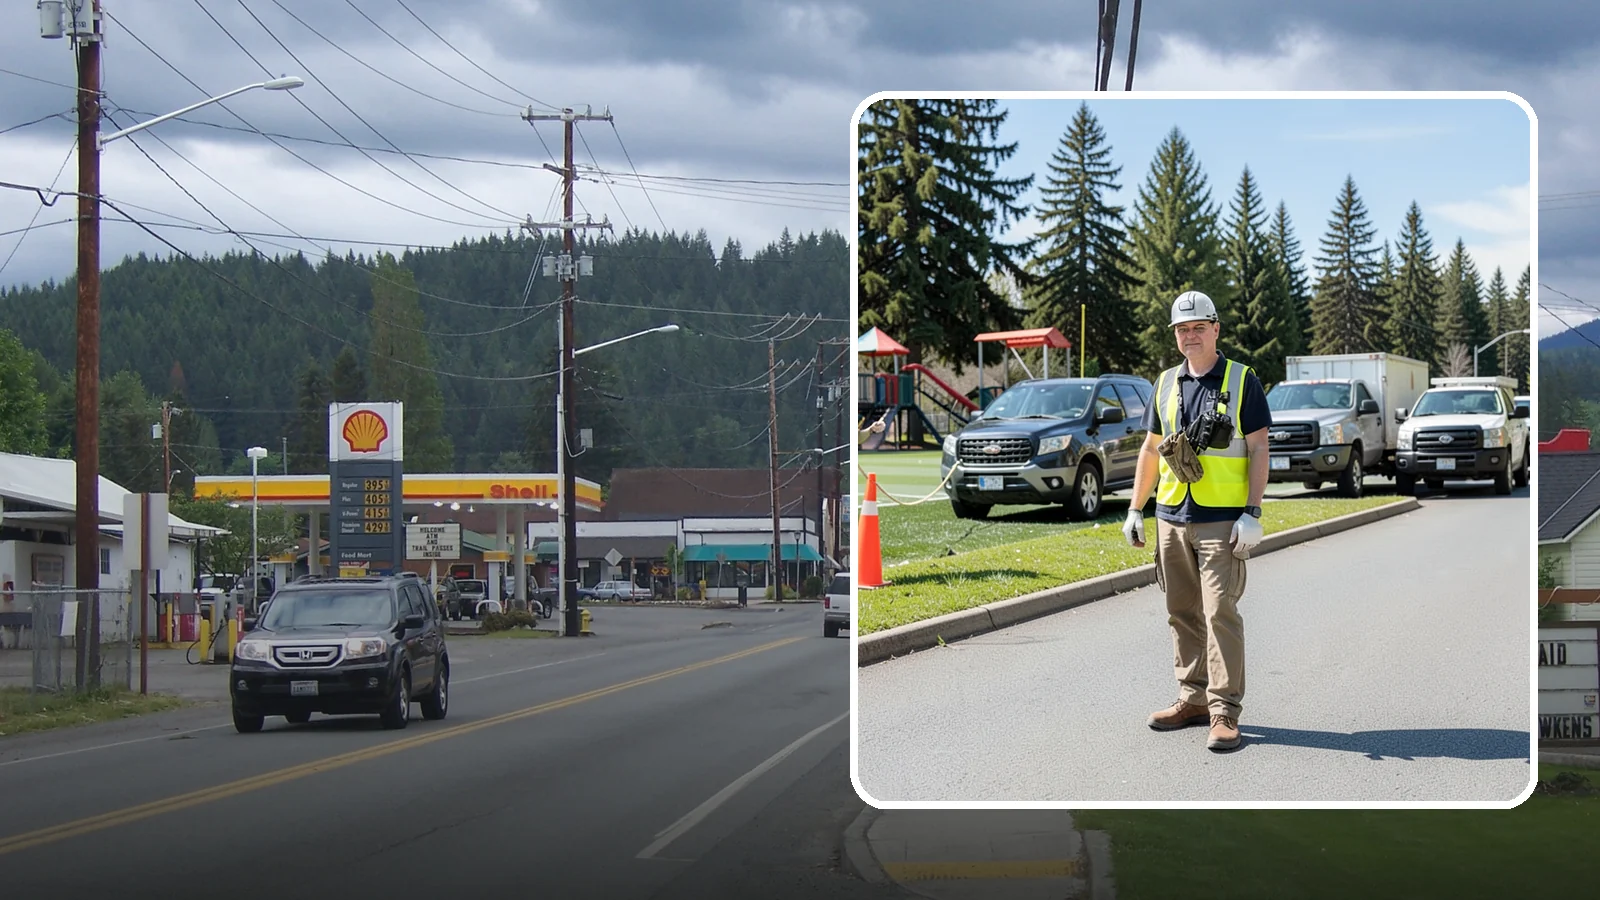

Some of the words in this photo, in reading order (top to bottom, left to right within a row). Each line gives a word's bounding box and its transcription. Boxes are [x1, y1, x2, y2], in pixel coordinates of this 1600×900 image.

[365, 480, 383, 490] 395
[490, 484, 547, 499] Shell
[365, 494, 383, 504] 405
[365, 508, 383, 518] 415
[365, 522, 383, 532] 429
